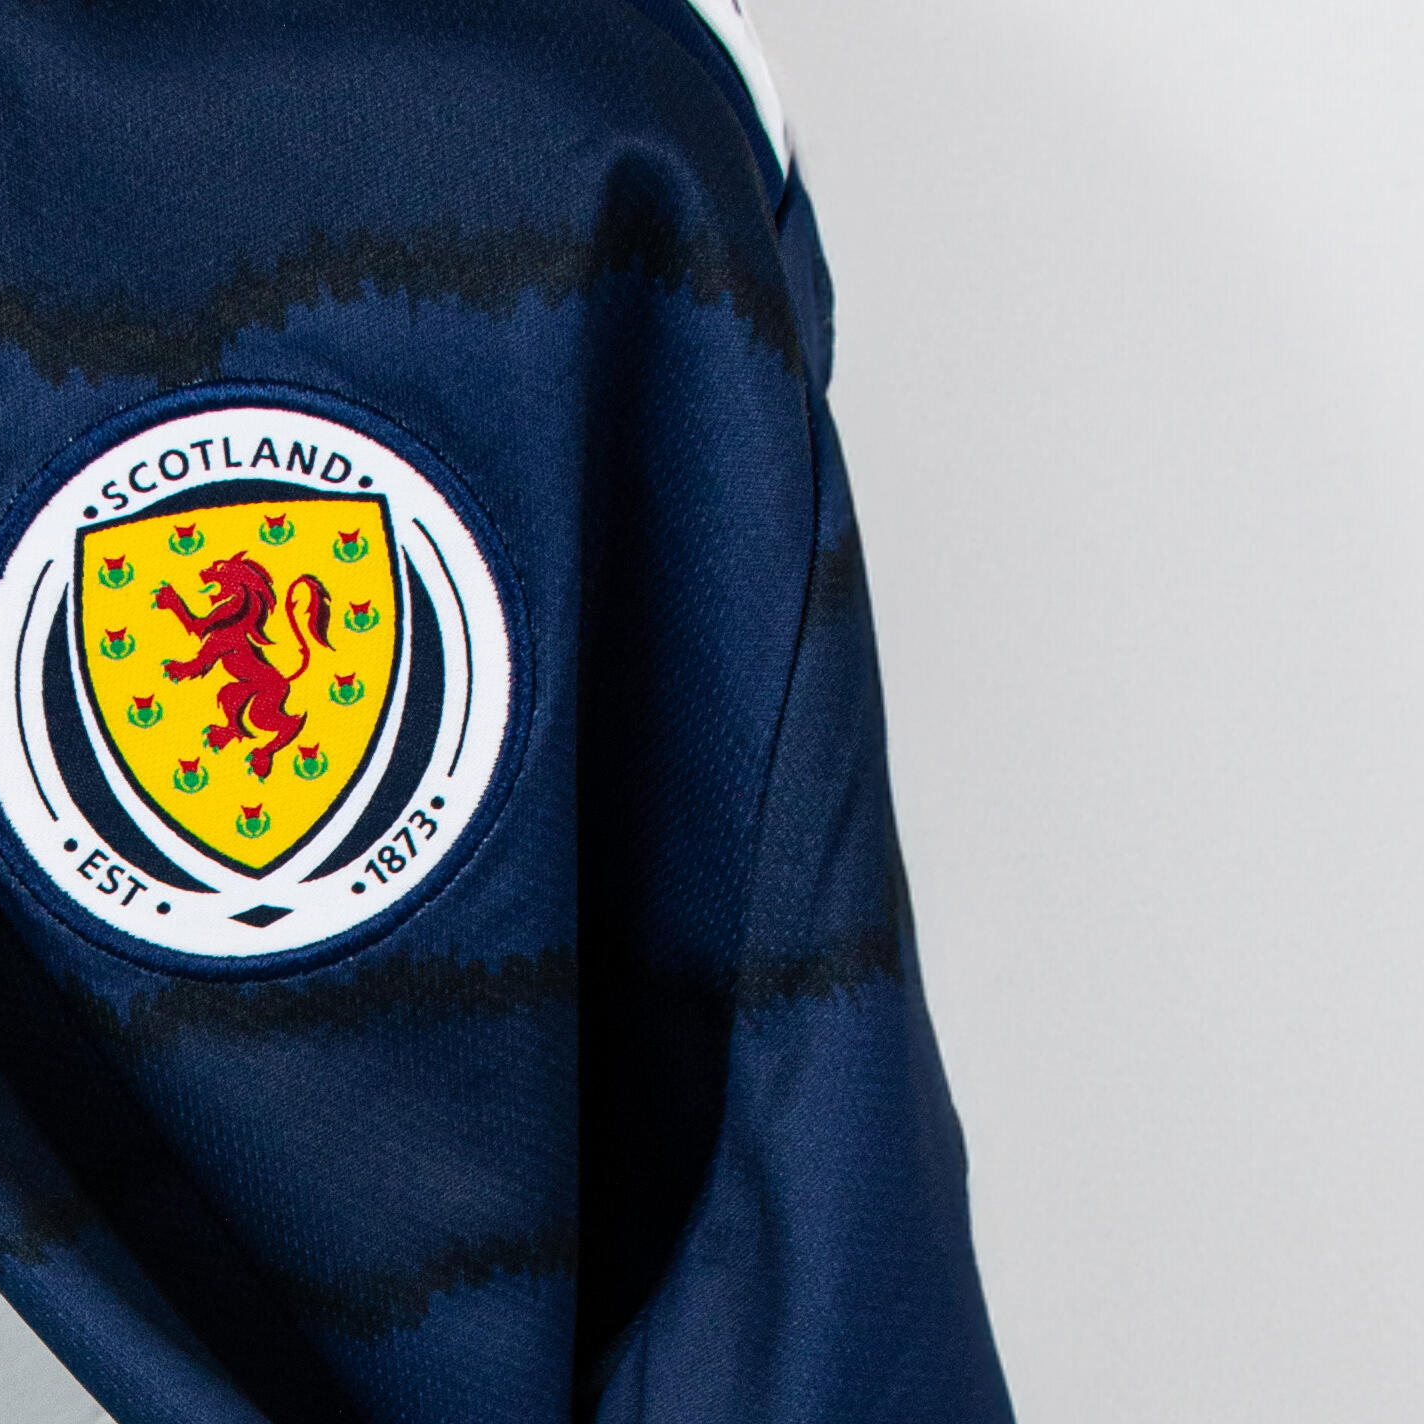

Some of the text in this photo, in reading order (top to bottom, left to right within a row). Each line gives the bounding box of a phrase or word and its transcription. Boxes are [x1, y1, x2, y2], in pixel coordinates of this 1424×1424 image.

[101, 437, 353, 510] SCOTLAND
[76, 848, 149, 906] EST
[364, 809, 438, 884] 1873
